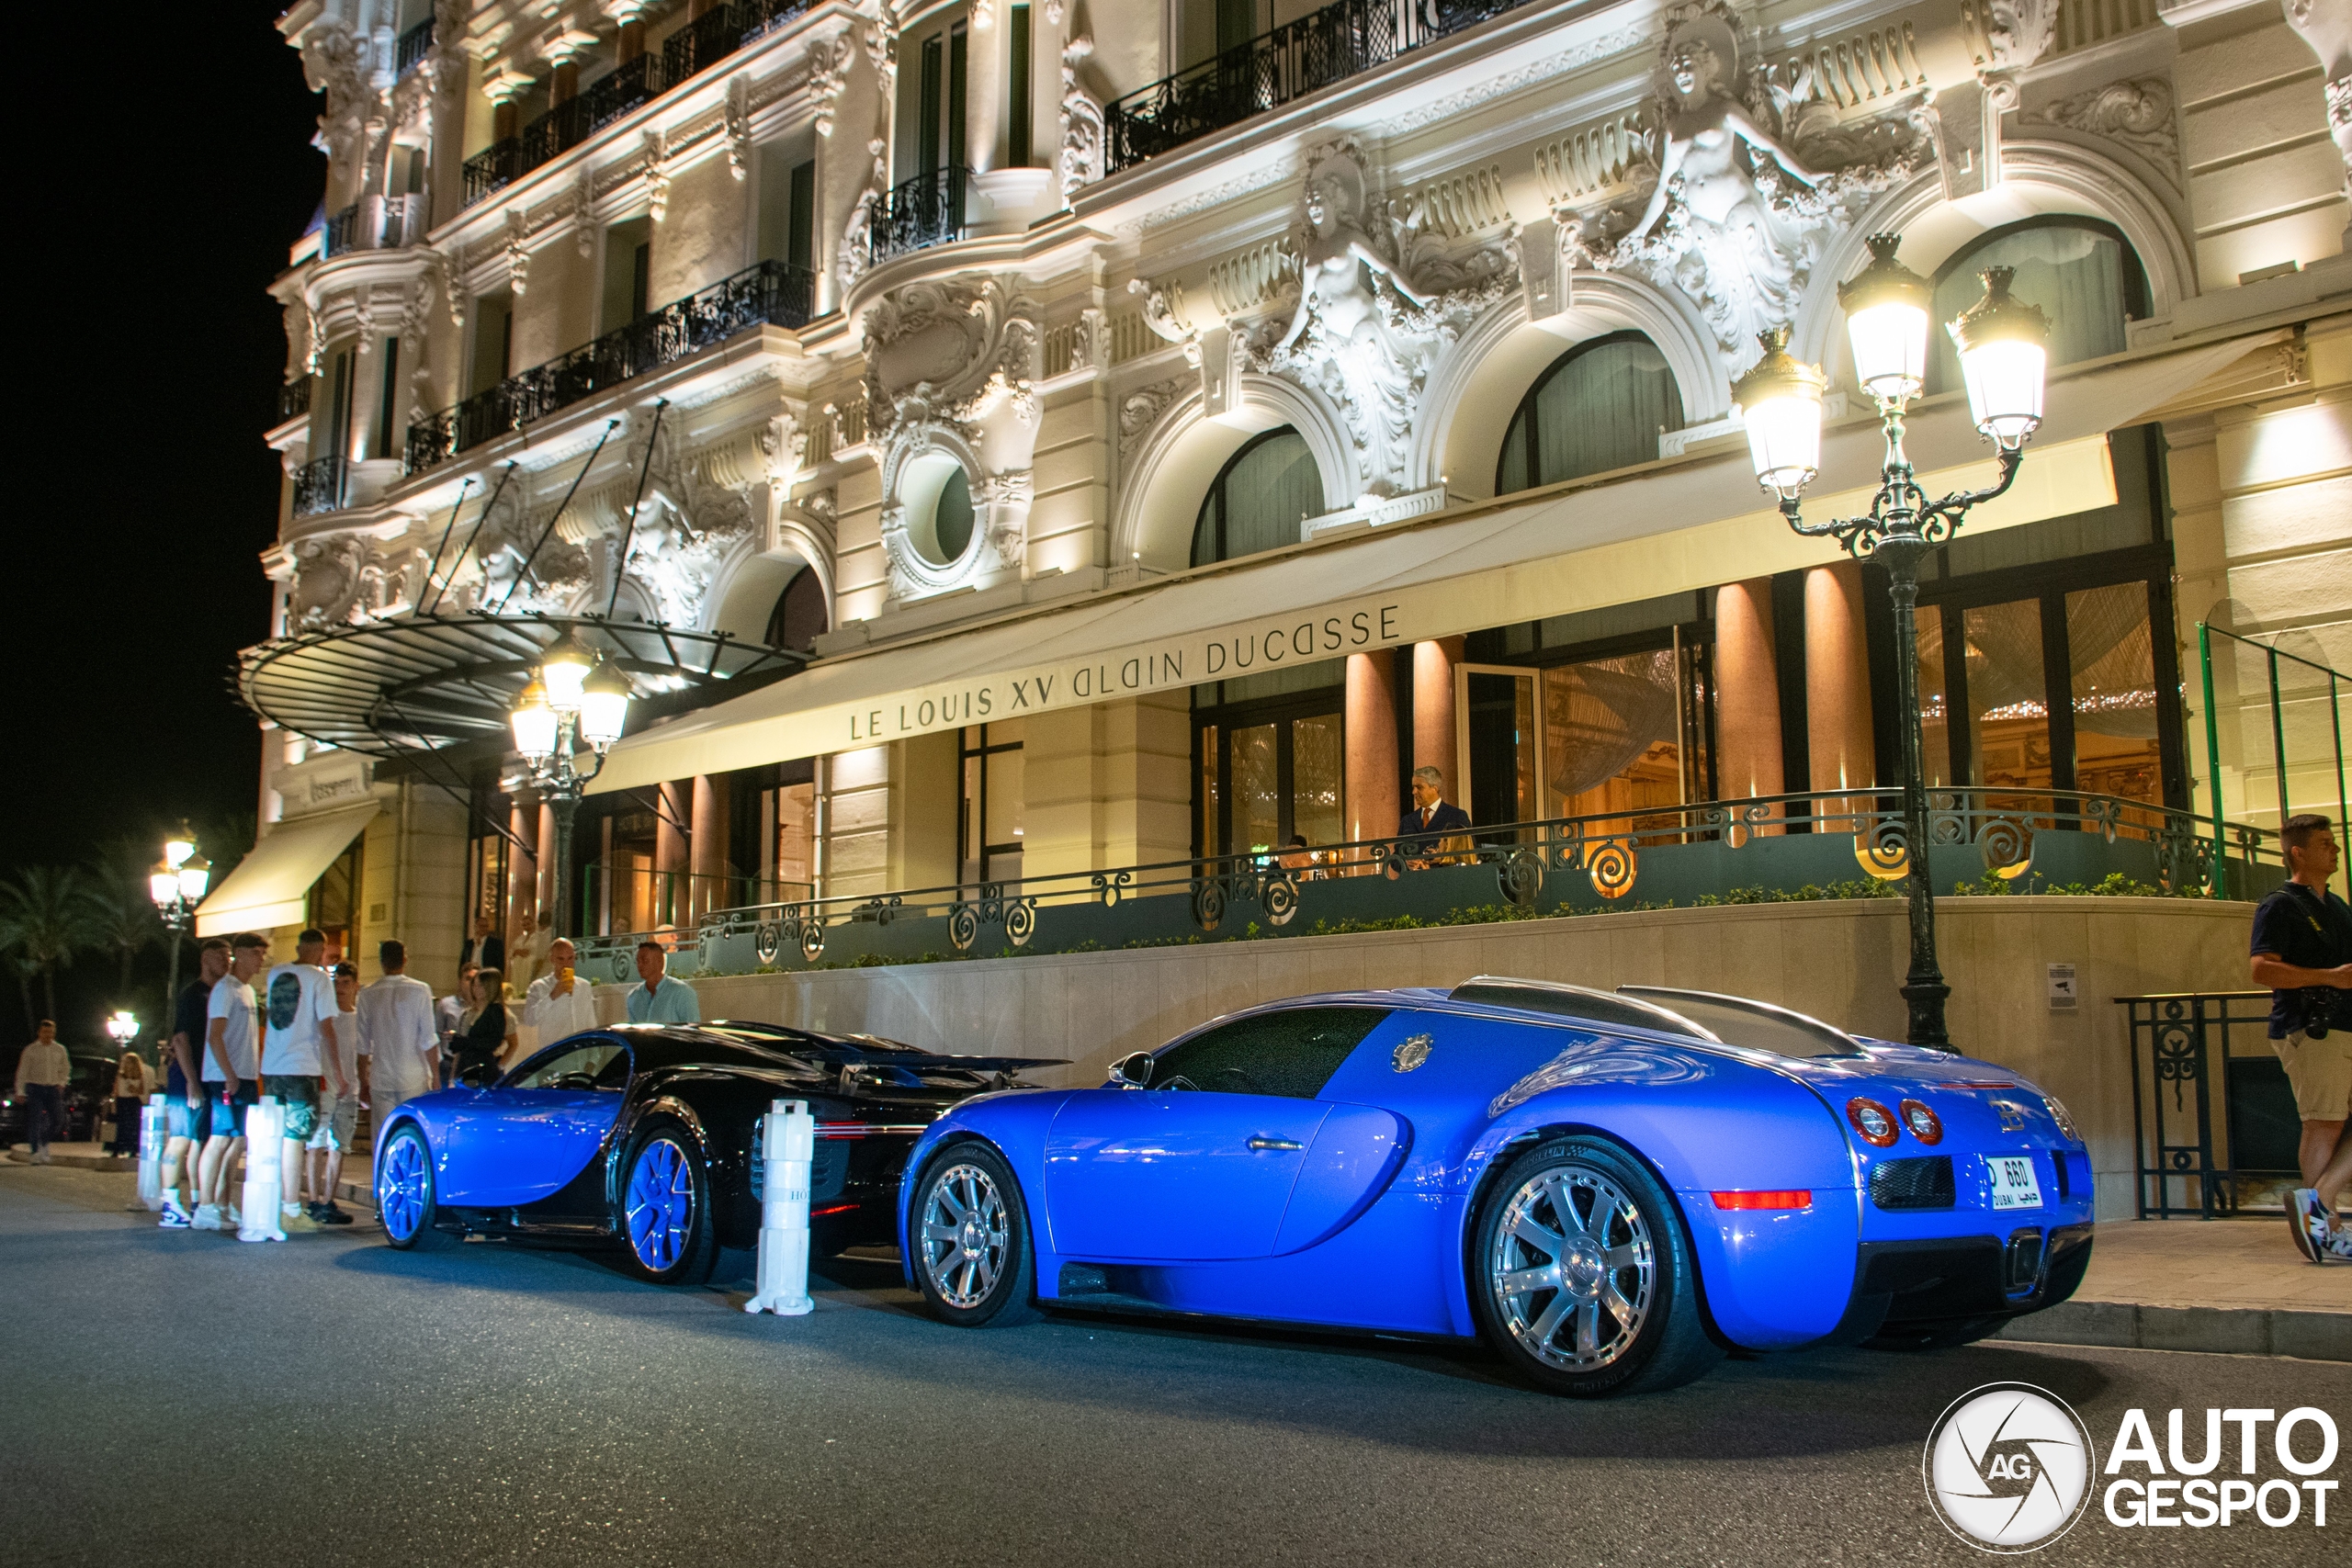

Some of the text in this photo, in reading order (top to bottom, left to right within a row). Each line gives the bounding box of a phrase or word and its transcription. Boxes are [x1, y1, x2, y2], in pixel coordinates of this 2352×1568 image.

[851, 710, 882, 740] LE
[900, 687, 992, 731] LOUIS
[1012, 674, 1054, 710] XV
[2004, 1160, 2029, 1188] 660
[1993, 1194, 2015, 1206] DUBAI
